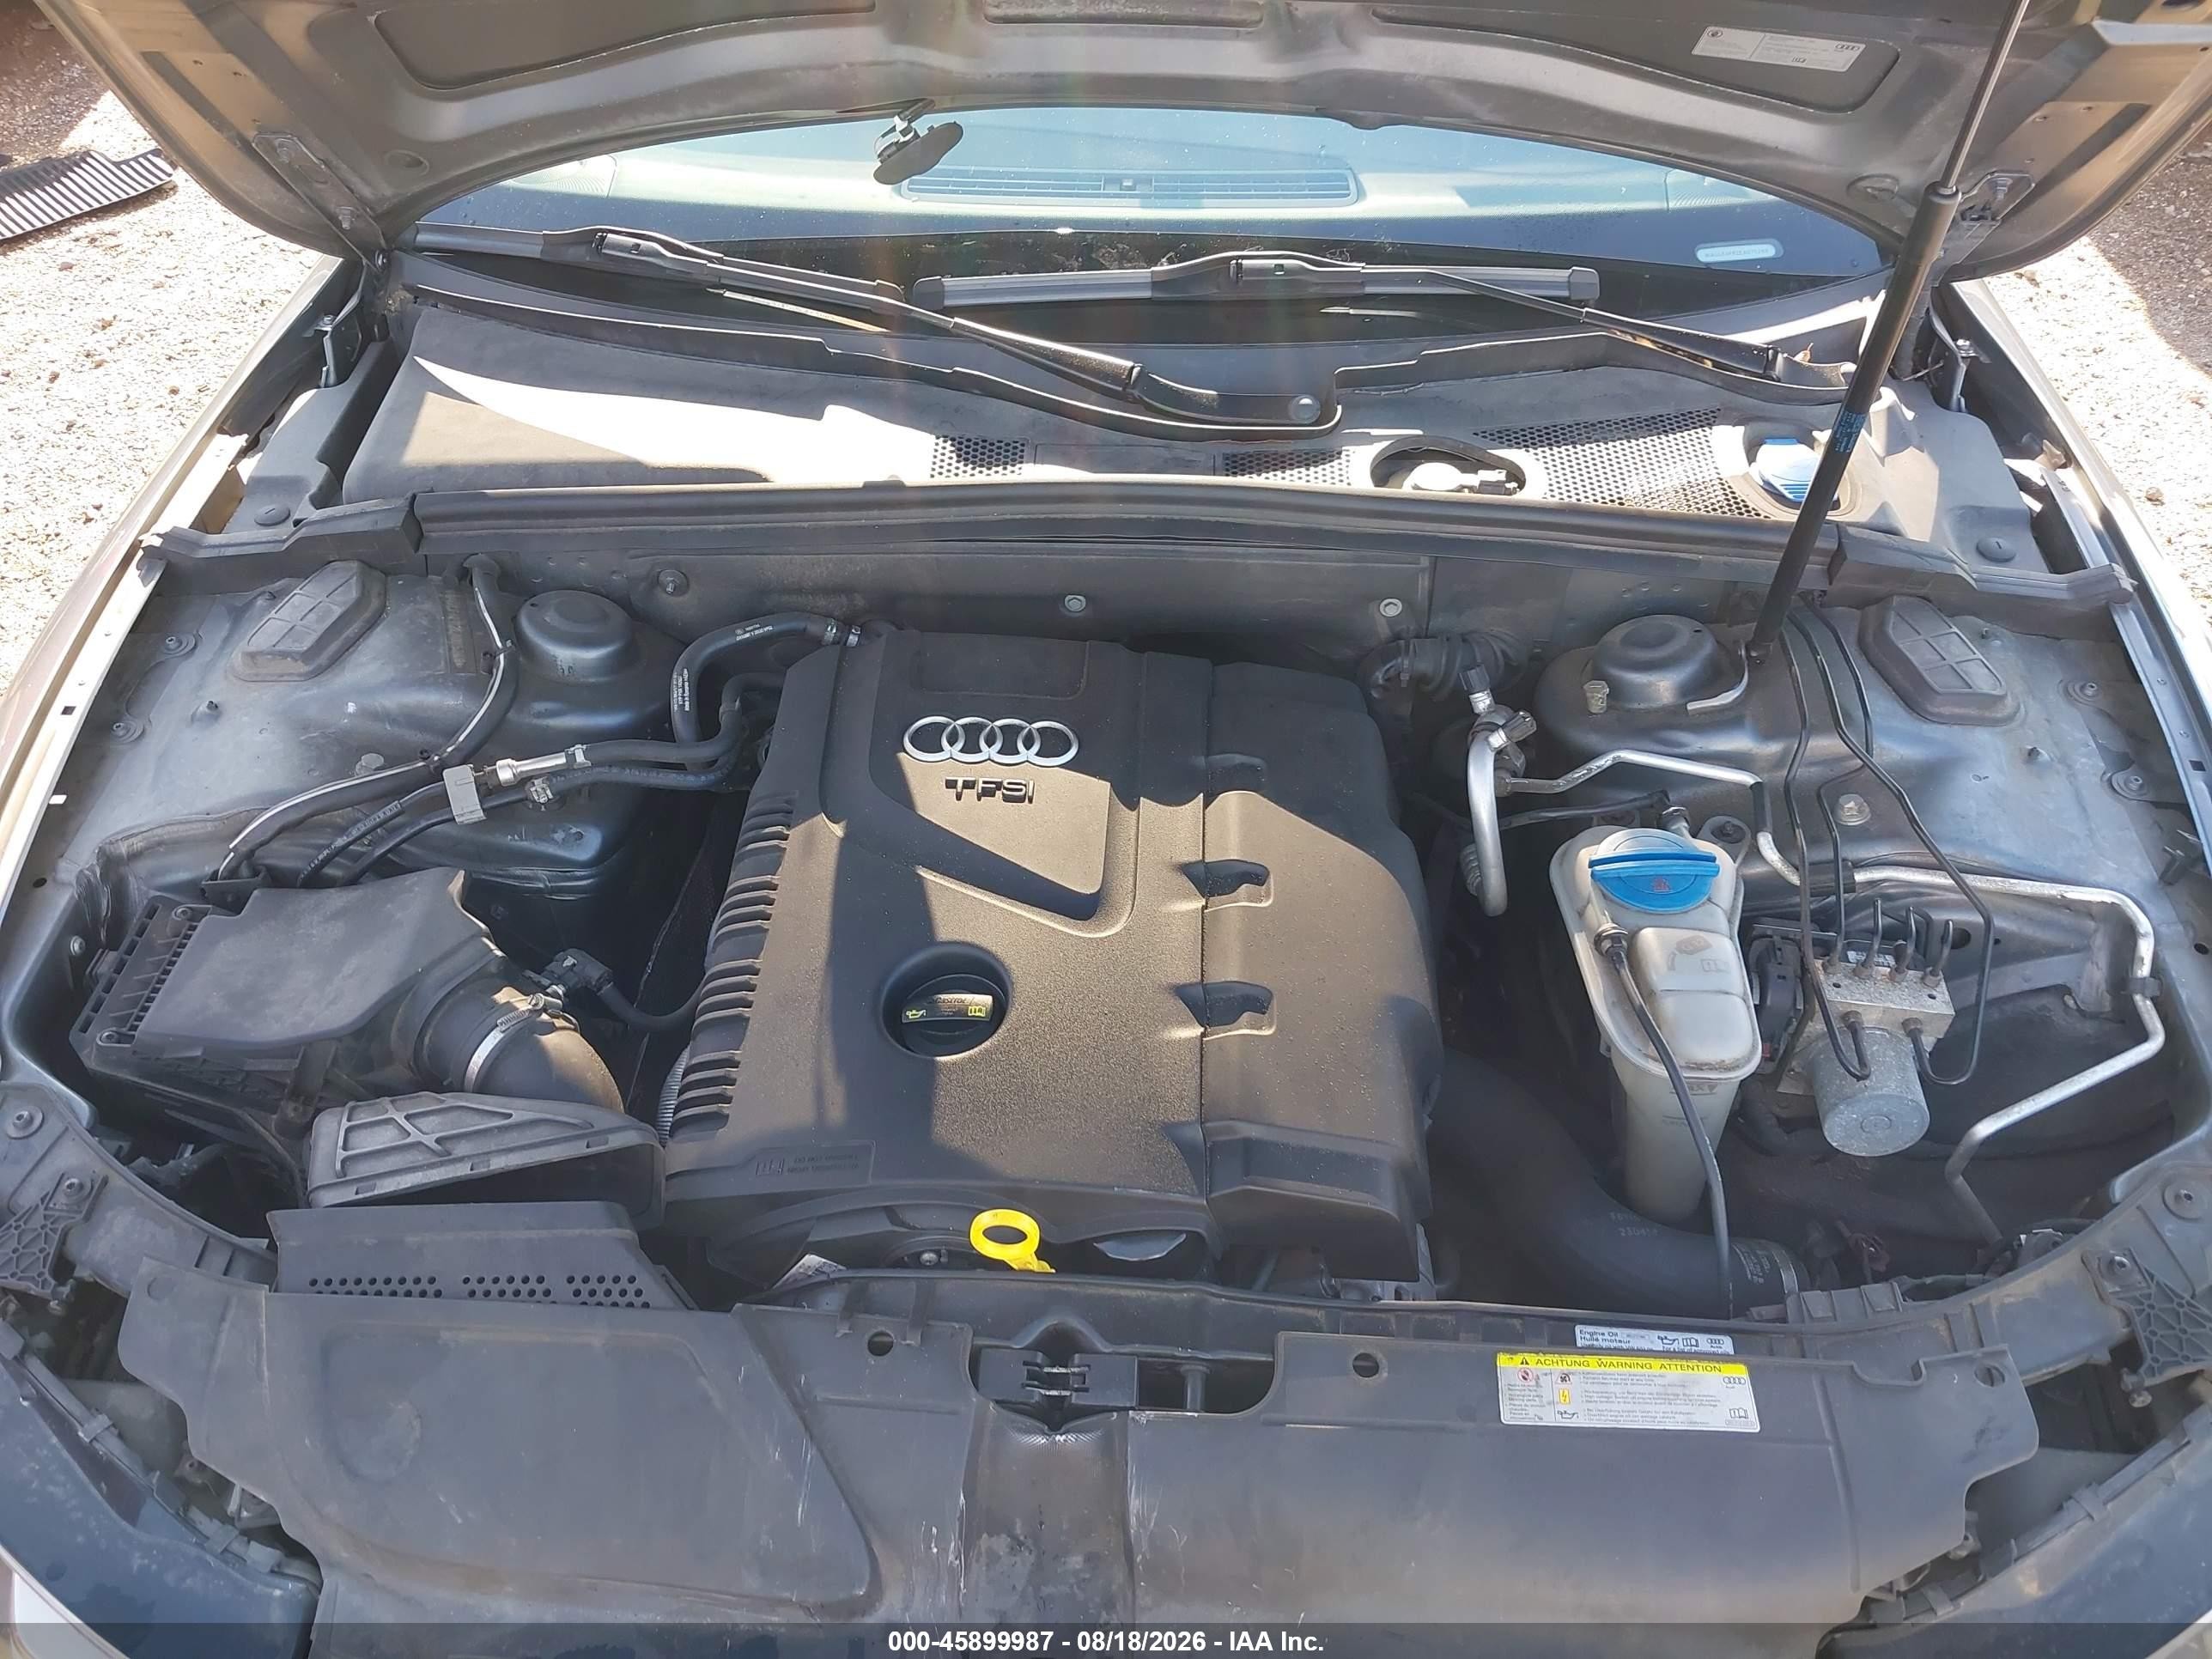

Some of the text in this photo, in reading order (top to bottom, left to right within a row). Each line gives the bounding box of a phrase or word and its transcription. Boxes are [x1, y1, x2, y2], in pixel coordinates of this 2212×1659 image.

[945, 776, 1035, 802] TFSI
[1579, 1329, 1606, 1339] Engine
[1607, 1330, 1619, 1339] Oil
[1535, 1358, 1722, 1372] ACHTUNG WARNING ATTENTION
